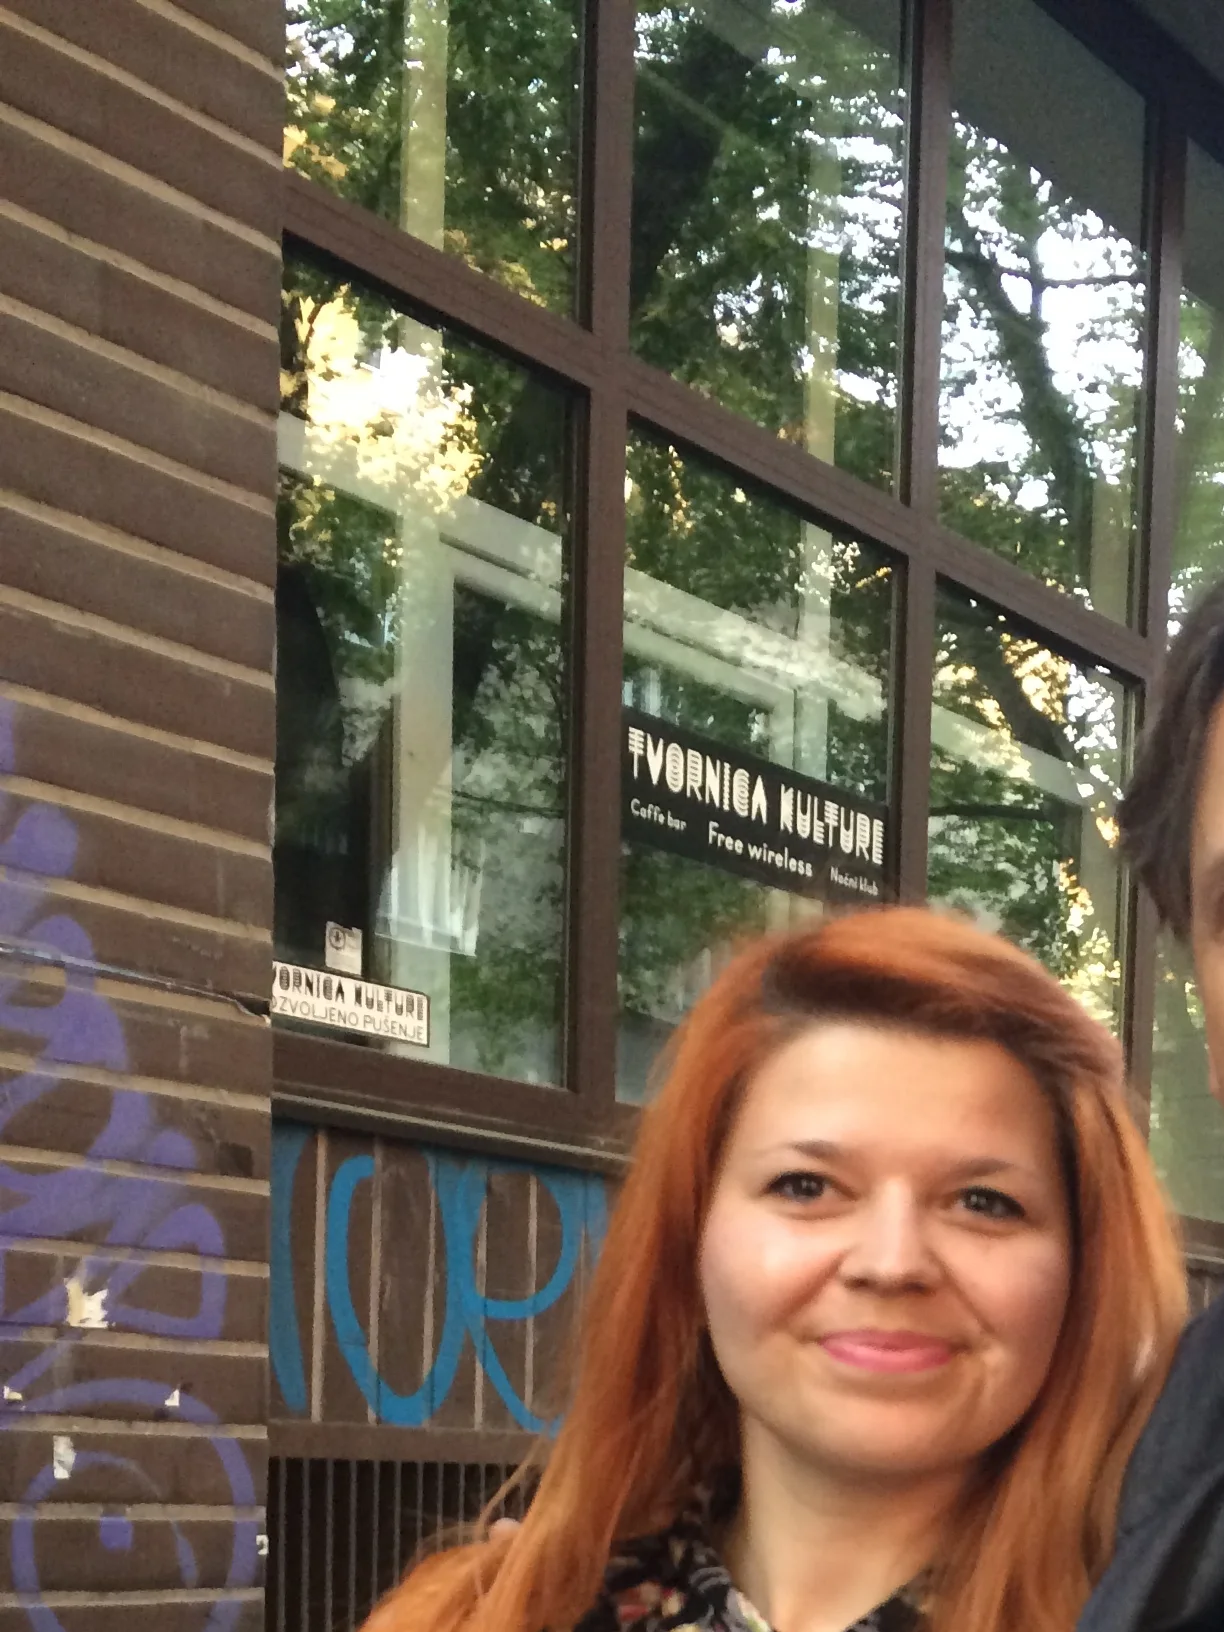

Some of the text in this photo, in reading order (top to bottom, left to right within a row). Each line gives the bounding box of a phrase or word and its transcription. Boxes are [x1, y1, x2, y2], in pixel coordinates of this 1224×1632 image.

[628, 726, 884, 865] TVORNICA KULTURE
[630, 798, 687, 832] Caffe bar
[708, 820, 813, 878] Free wireless
[354, 982, 424, 1021] KULTURE
[363, 1013, 424, 1041] PUŠENJE
